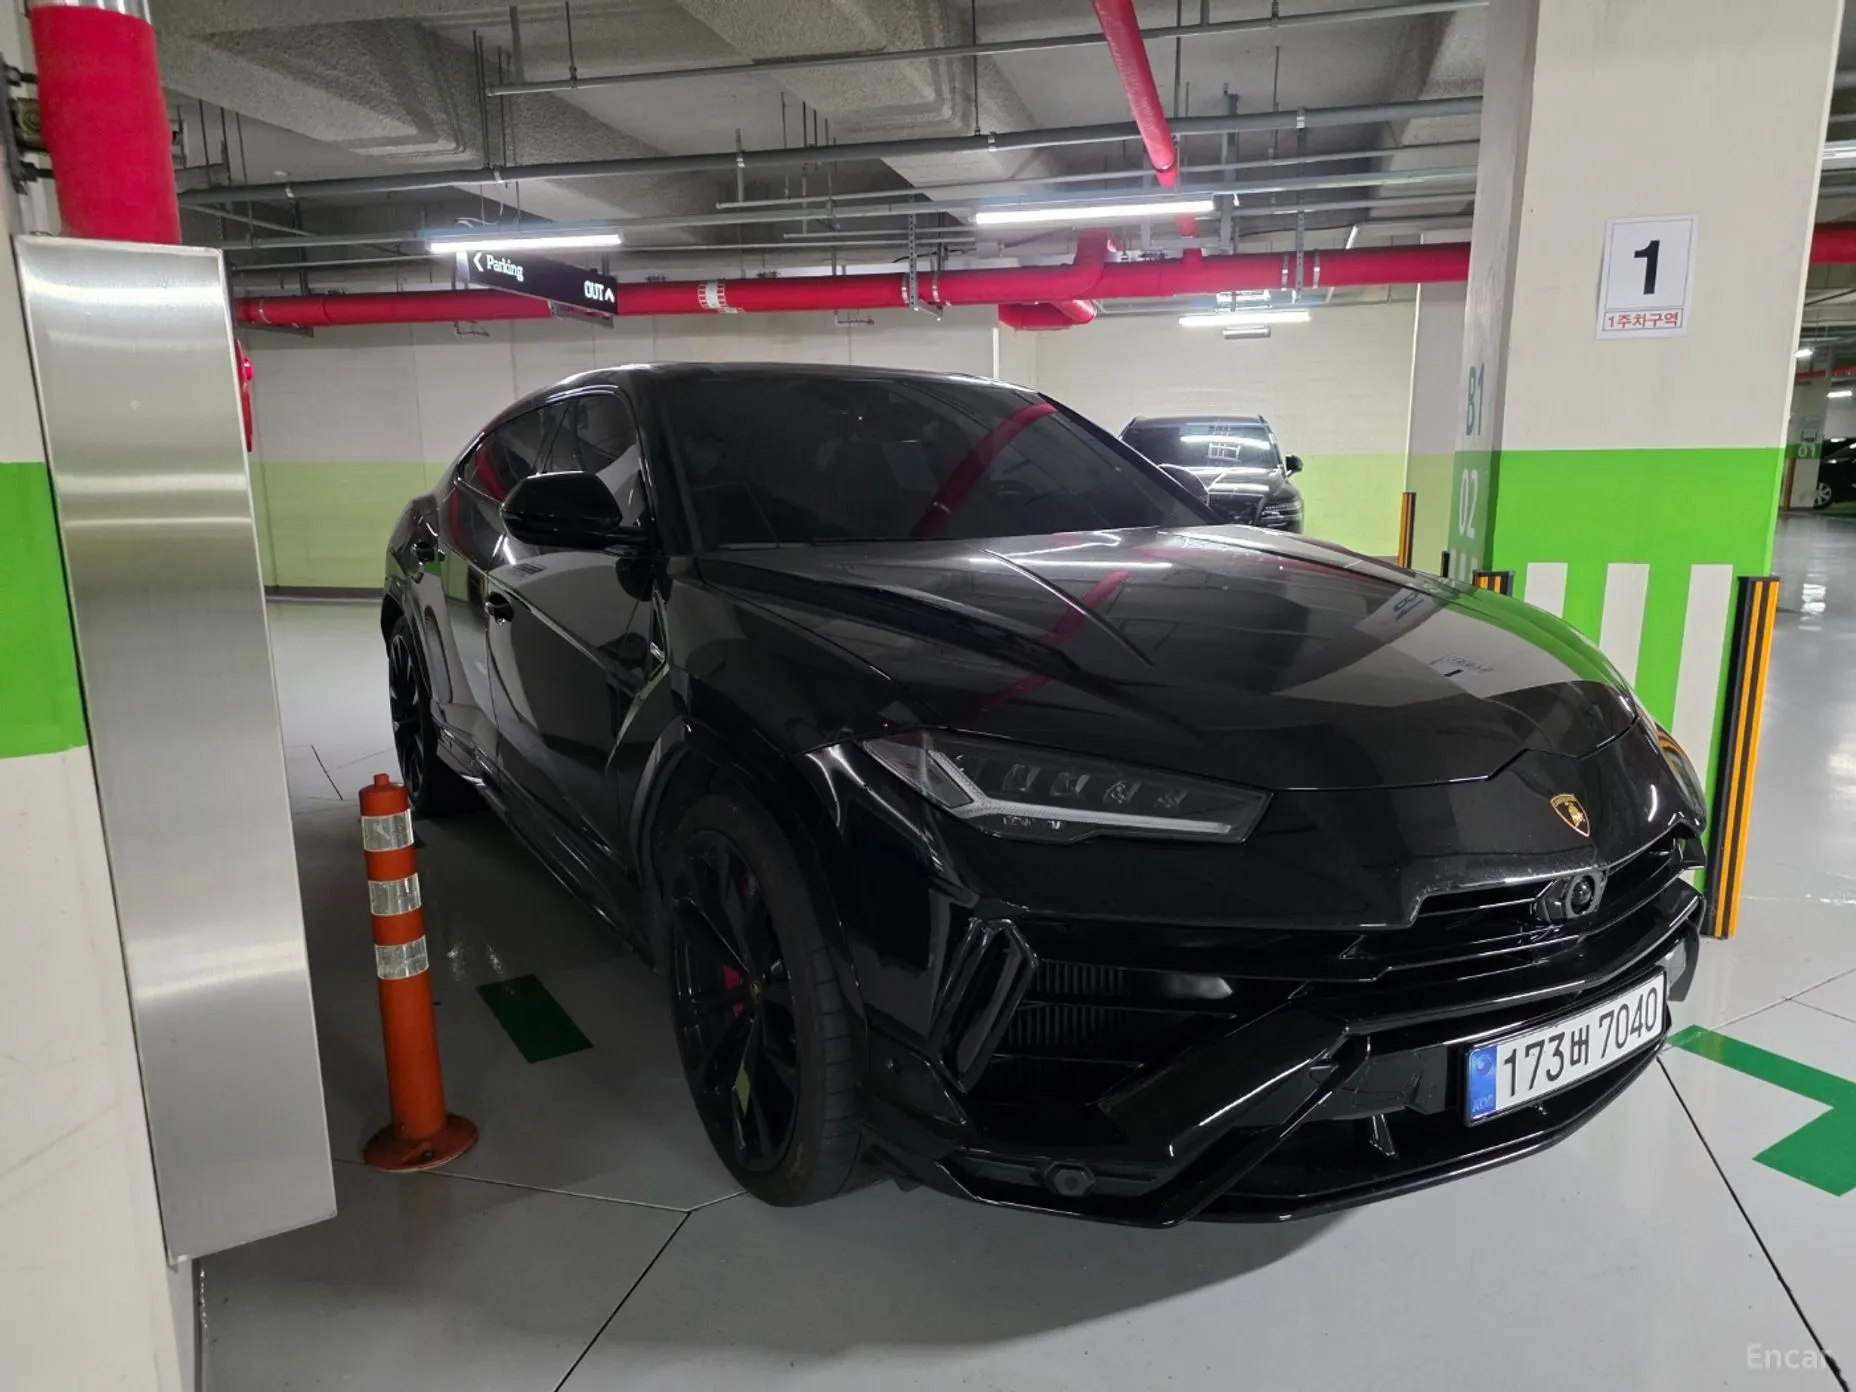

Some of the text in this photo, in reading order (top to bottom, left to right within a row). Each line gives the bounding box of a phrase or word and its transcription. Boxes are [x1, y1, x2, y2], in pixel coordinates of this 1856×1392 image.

[486, 254, 524, 282] Parking
[583, 280, 605, 301] OUT
[1633, 239, 1661, 295] 1
[1607, 310, 1679, 329] 1주차구역
[1466, 362, 1485, 436] B1
[1457, 468, 1479, 539] 02
[1503, 986, 1658, 1097] 173버 7040
